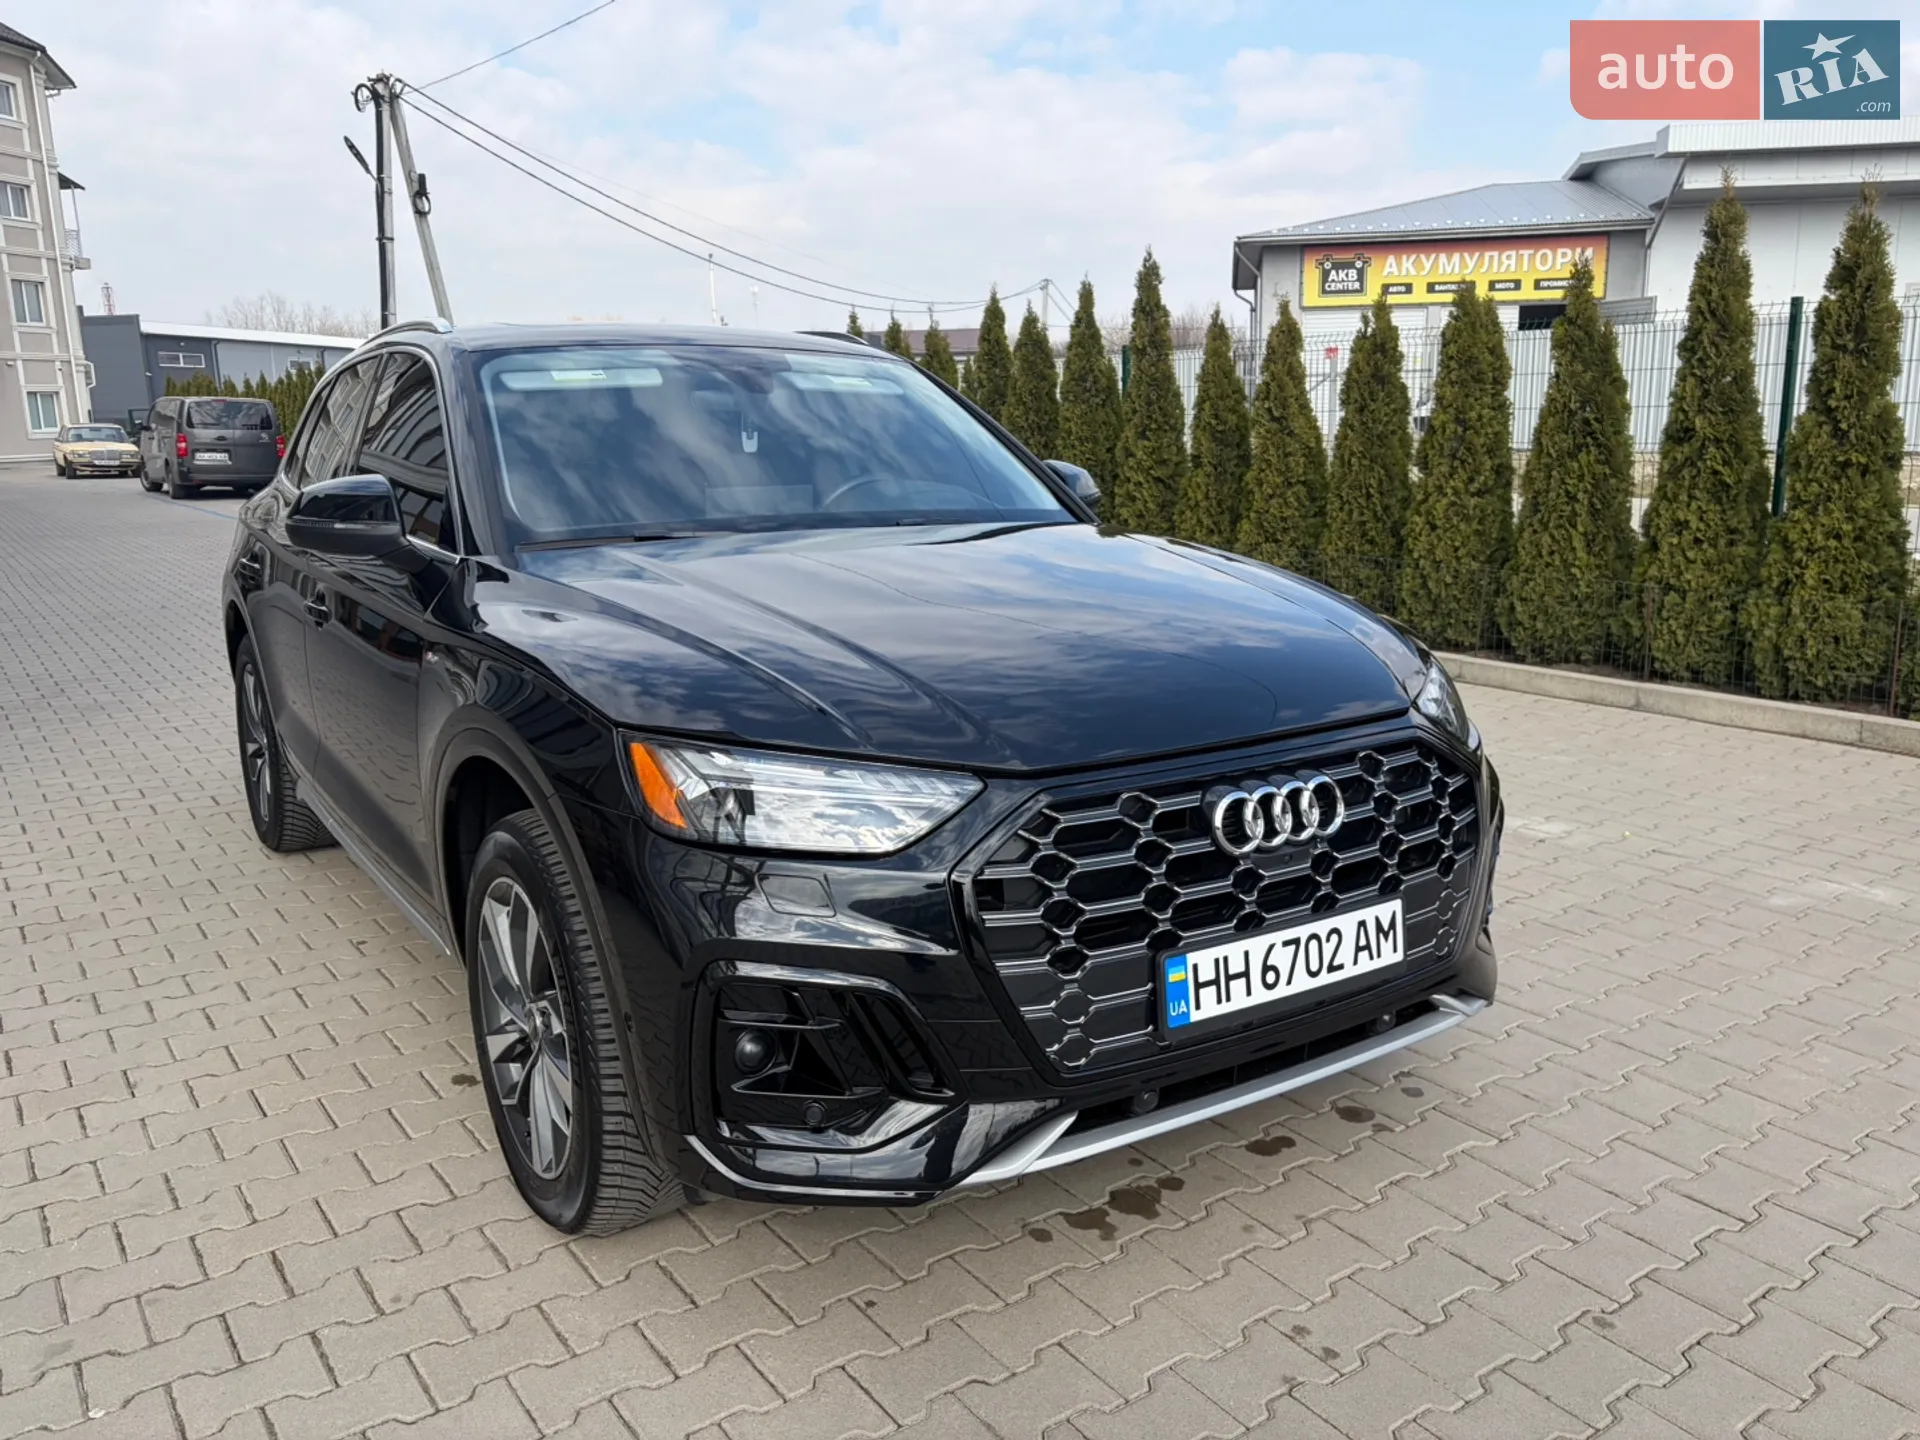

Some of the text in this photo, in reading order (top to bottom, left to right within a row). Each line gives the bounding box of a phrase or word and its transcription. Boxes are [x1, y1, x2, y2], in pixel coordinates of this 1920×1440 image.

[1382, 246, 1595, 277] АКУМУЛЯТОРИ
[1325, 281, 1360, 291] CENTER
[1192, 910, 1398, 1012] HH 6702 AM
[1169, 999, 1188, 1016] UA
